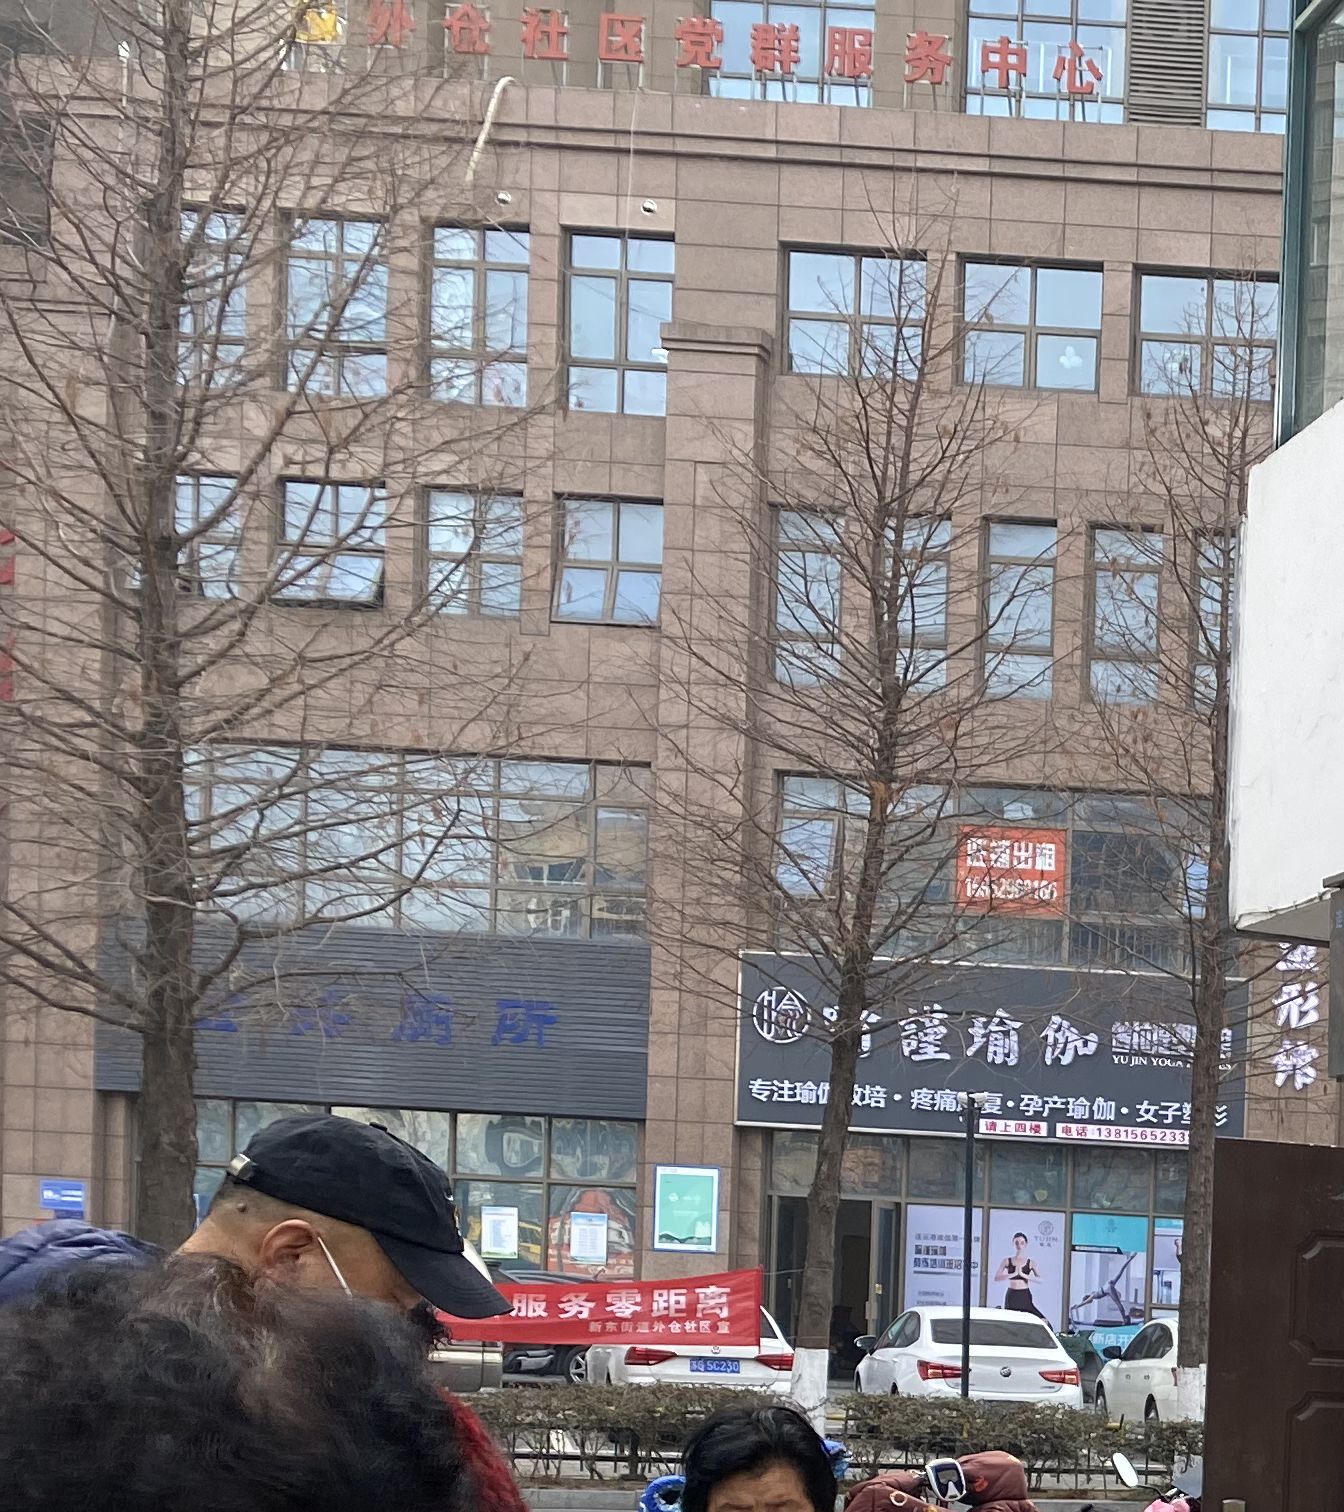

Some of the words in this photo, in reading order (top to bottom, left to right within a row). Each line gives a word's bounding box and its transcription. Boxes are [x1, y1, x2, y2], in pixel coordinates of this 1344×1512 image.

[1111, 1054, 1128, 1065] YU
[1129, 1055, 1148, 1067] JIN
[588, 1320, 711, 1334] 新东街道外仓社区
